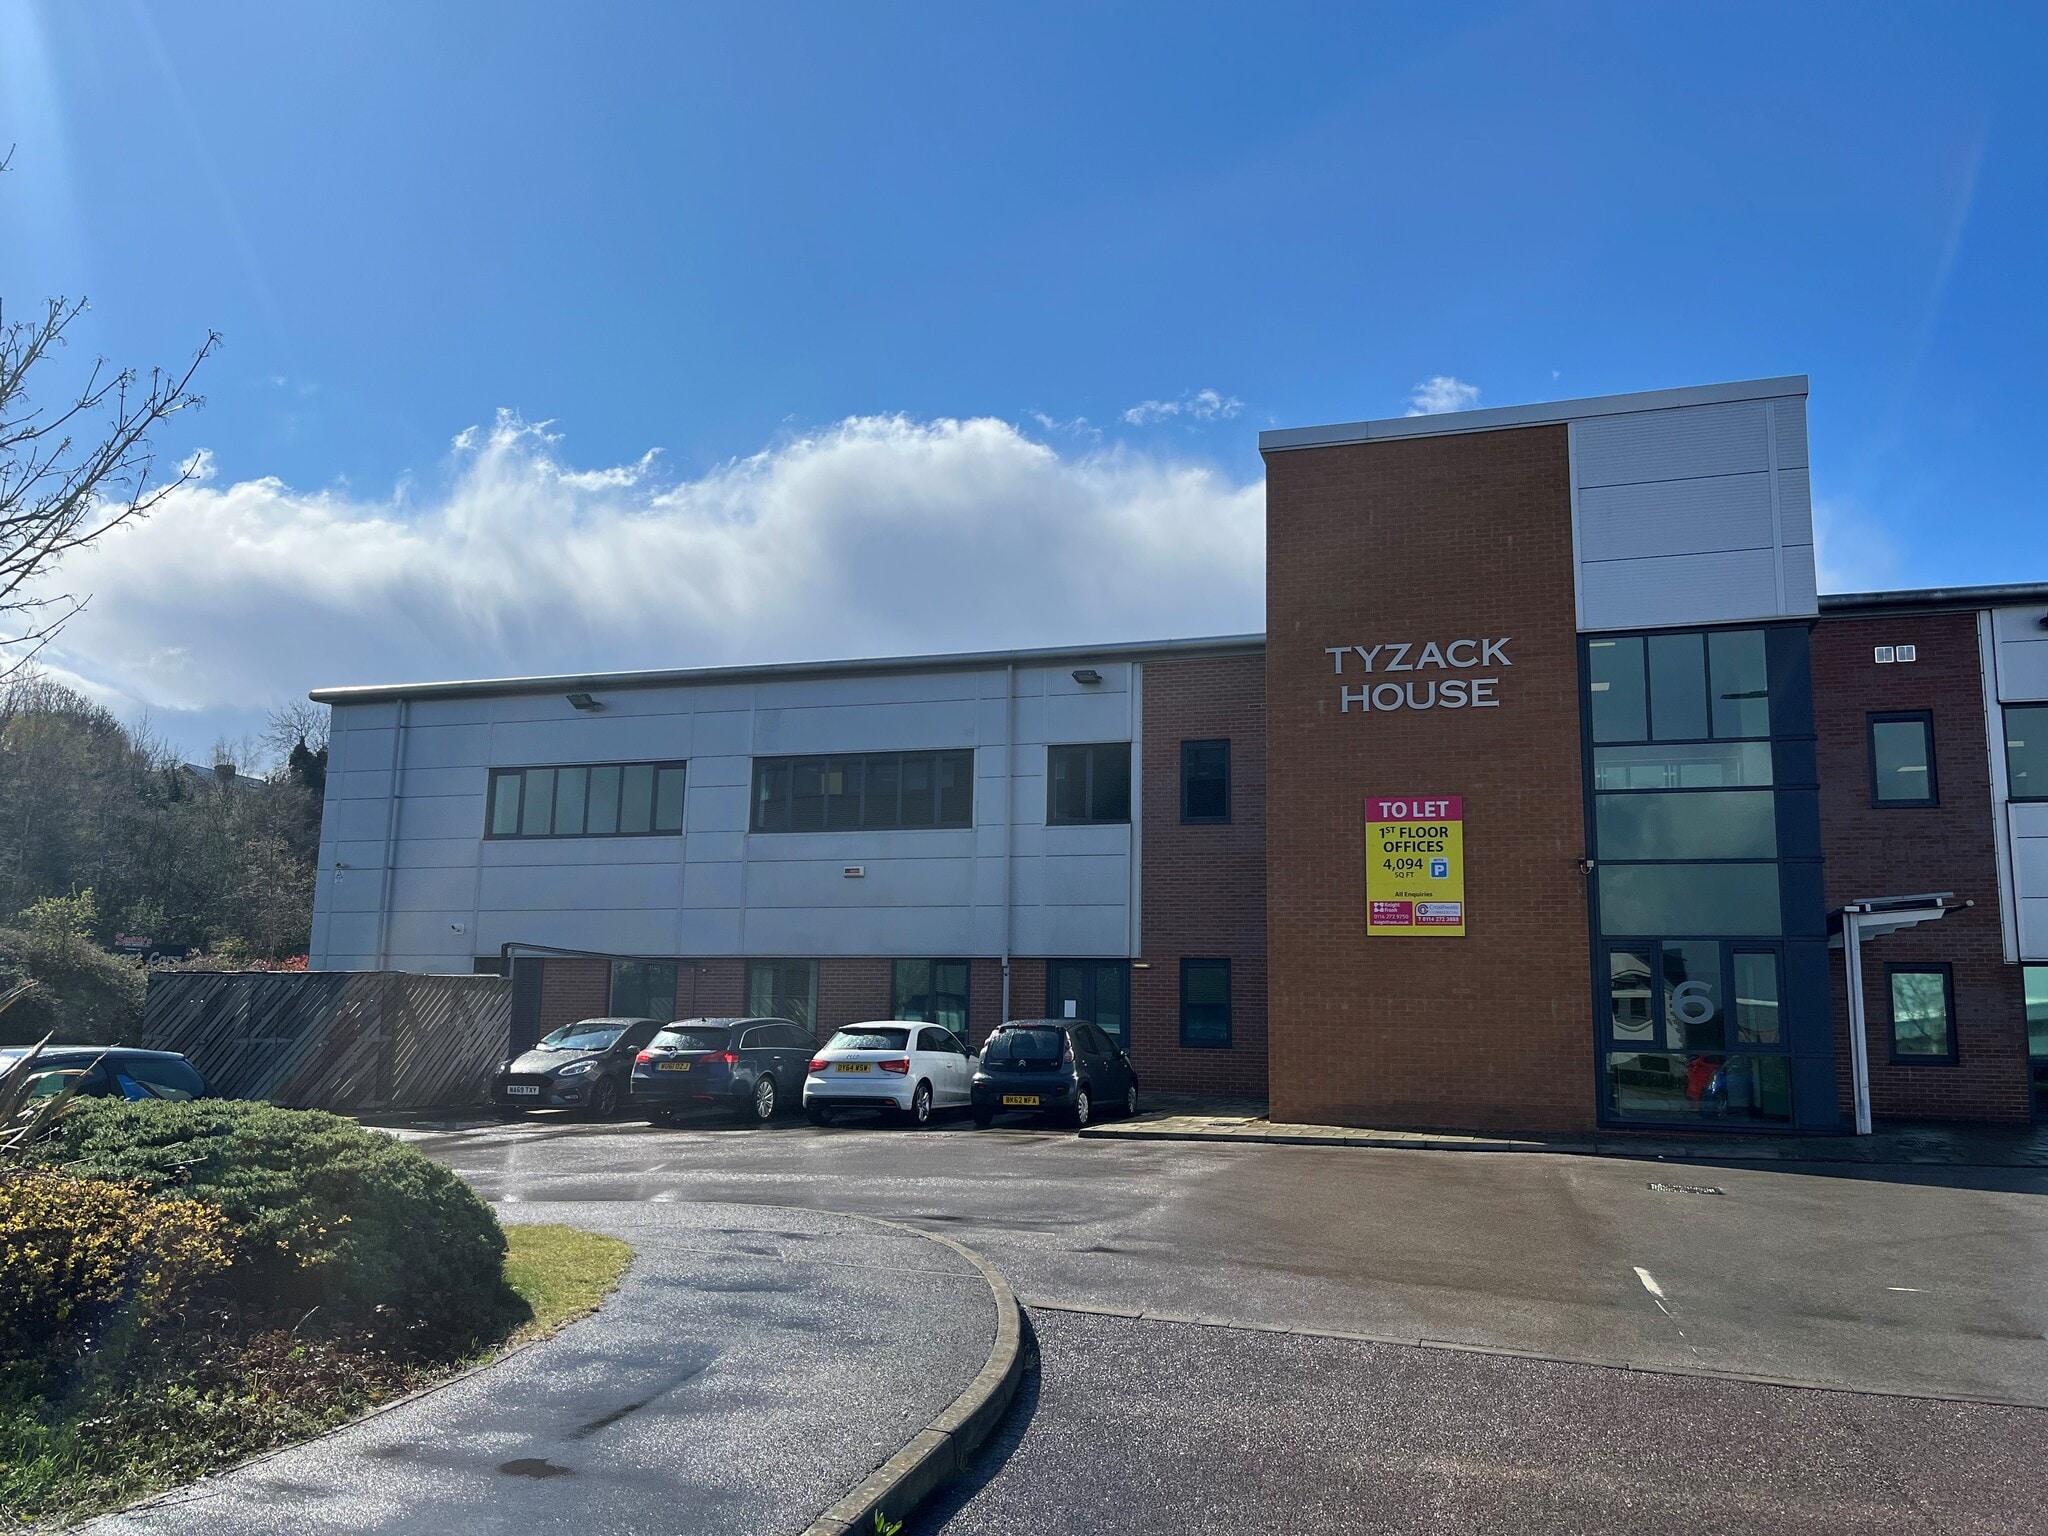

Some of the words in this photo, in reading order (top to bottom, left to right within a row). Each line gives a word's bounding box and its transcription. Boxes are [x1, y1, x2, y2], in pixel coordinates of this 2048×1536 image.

[1325, 637, 1513, 674] TYZACK
[1340, 677, 1499, 713] HOUSE
[1379, 801, 1407, 818] TO
[1413, 801, 1449, 817] LET
[1379, 826, 1396, 839] 1ST
[1399, 826, 1449, 838] FLOOR
[1383, 840, 1444, 853] OFFICES
[1383, 858, 1423, 872] 4,094
[1434, 864, 1445, 876] P
[1394, 871, 1405, 879] SQ
[1672, 980, 1714, 1025] 6
